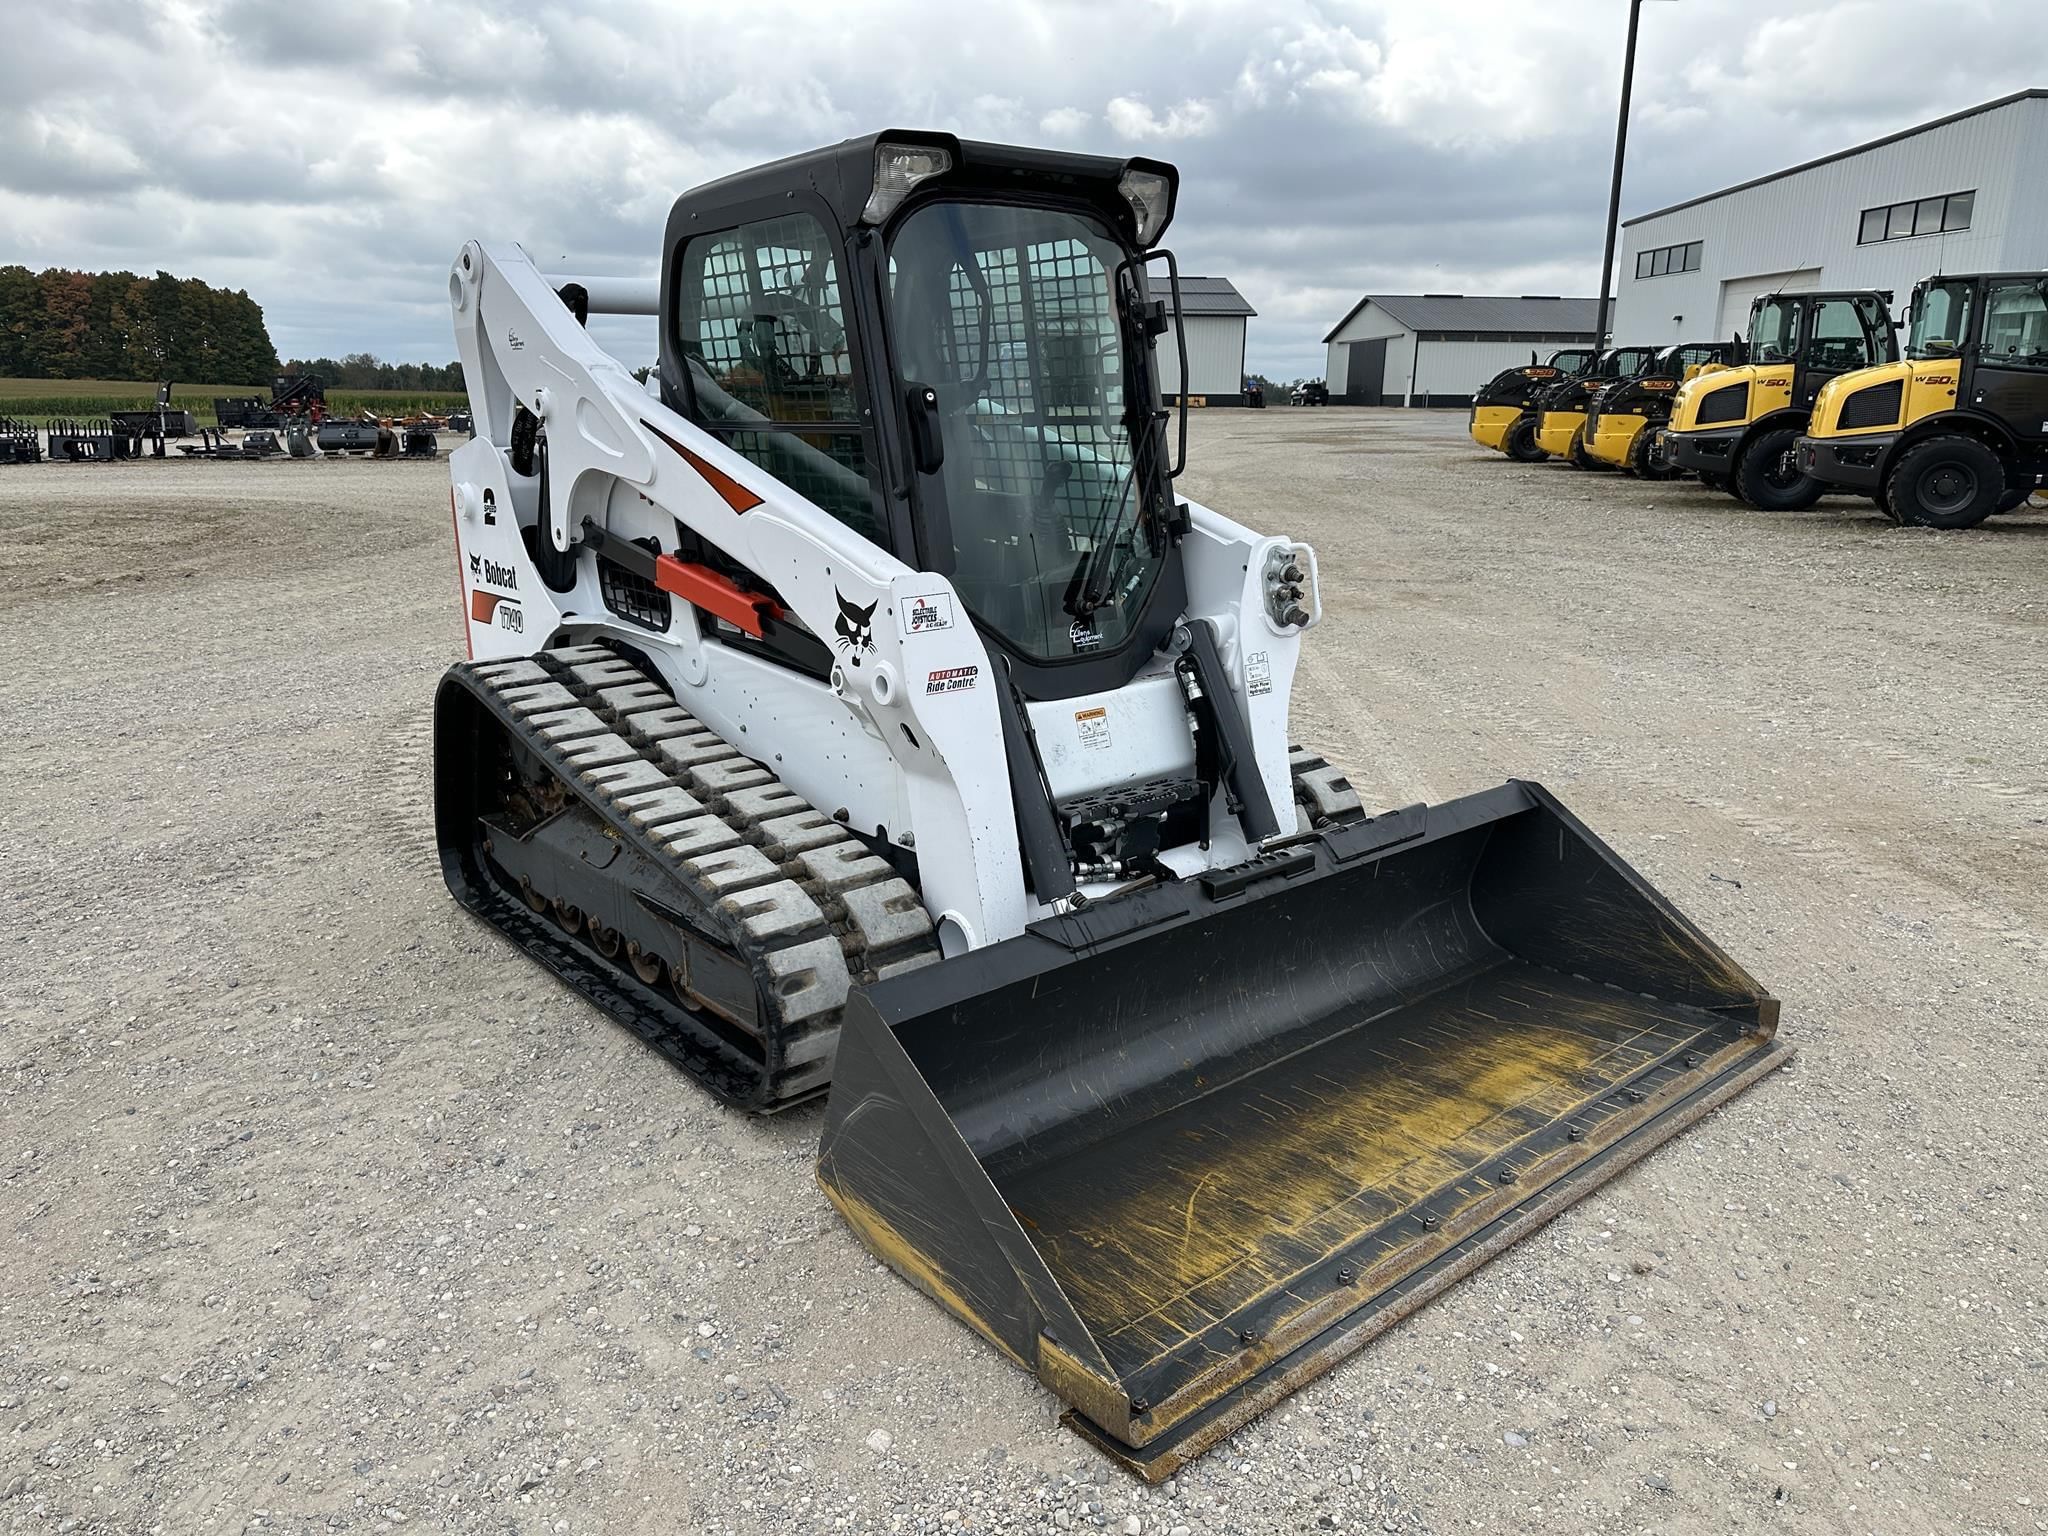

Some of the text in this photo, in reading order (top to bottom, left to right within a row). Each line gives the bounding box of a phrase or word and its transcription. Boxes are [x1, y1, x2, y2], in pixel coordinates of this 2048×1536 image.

[483, 558, 518, 590] Bobcat
[499, 605, 523, 634] T740
[911, 613, 938, 625] JOYSTICKS
[929, 667, 977, 681] AUTOMATIC
[926, 680, 946, 693] Ride
